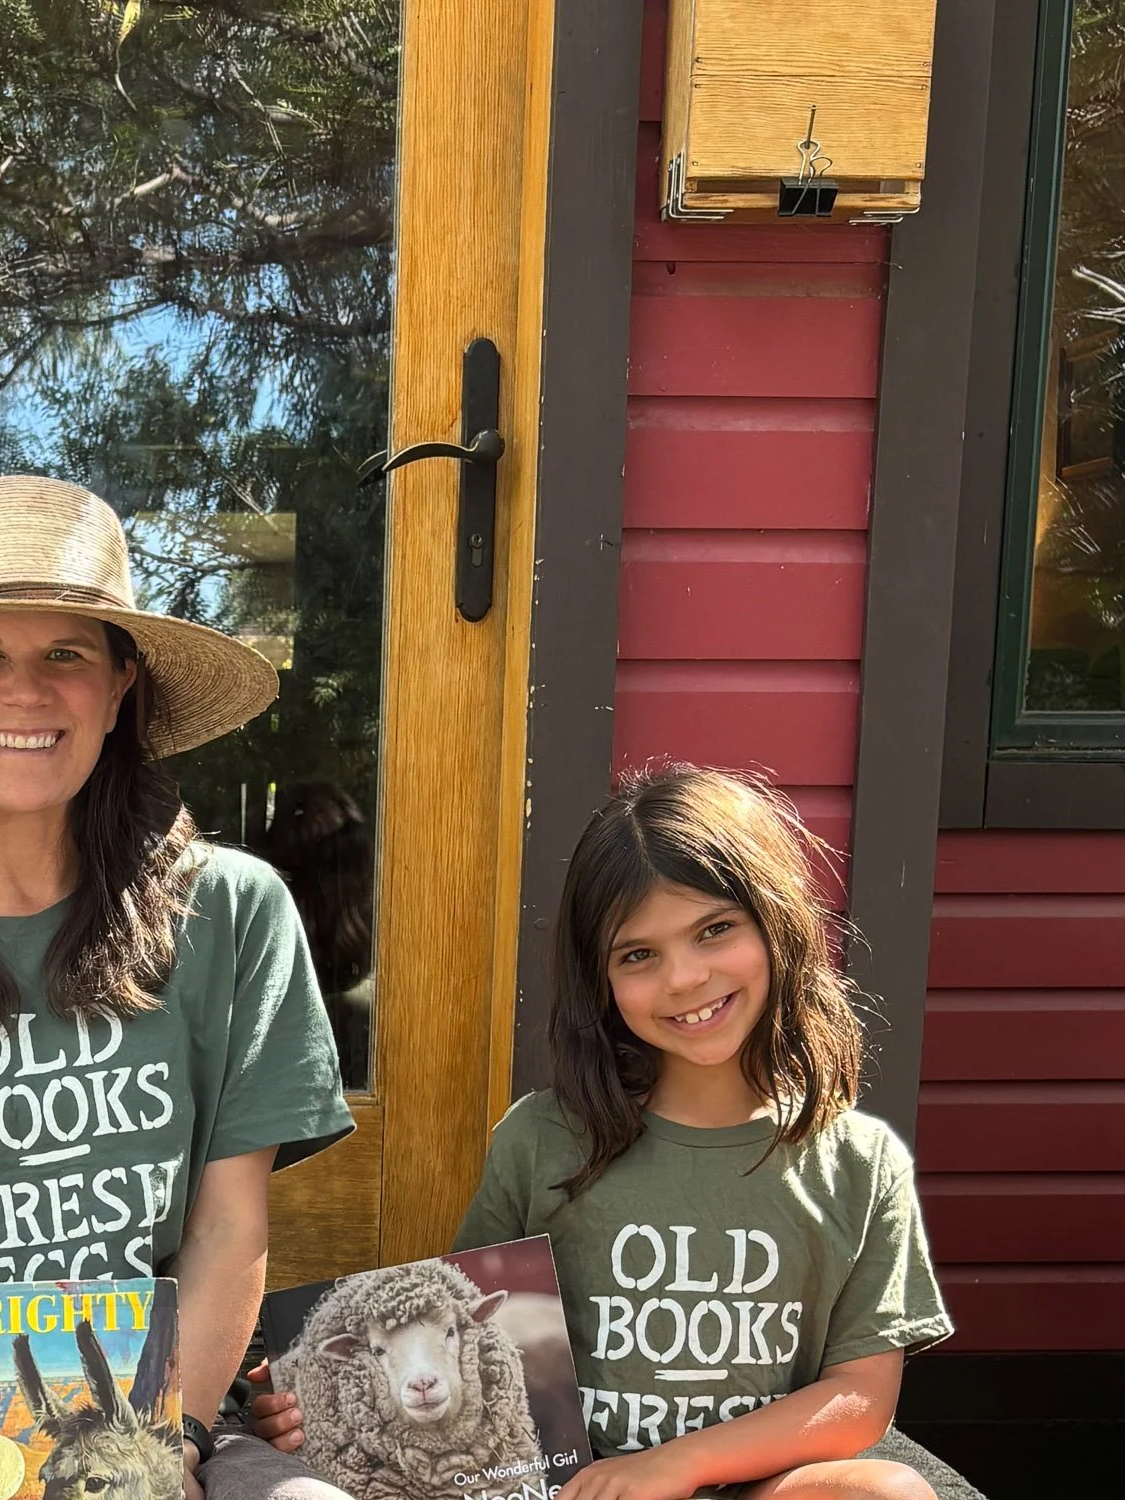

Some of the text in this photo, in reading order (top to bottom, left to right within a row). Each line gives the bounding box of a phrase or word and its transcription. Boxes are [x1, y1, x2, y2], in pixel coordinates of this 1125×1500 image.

[611, 1224, 779, 1293] OLD
[589, 1296, 803, 1364] BOOKS
[578, 1386, 787, 1450] FRE
[454, 1449, 578, 1486] Our Wonderful Girl
